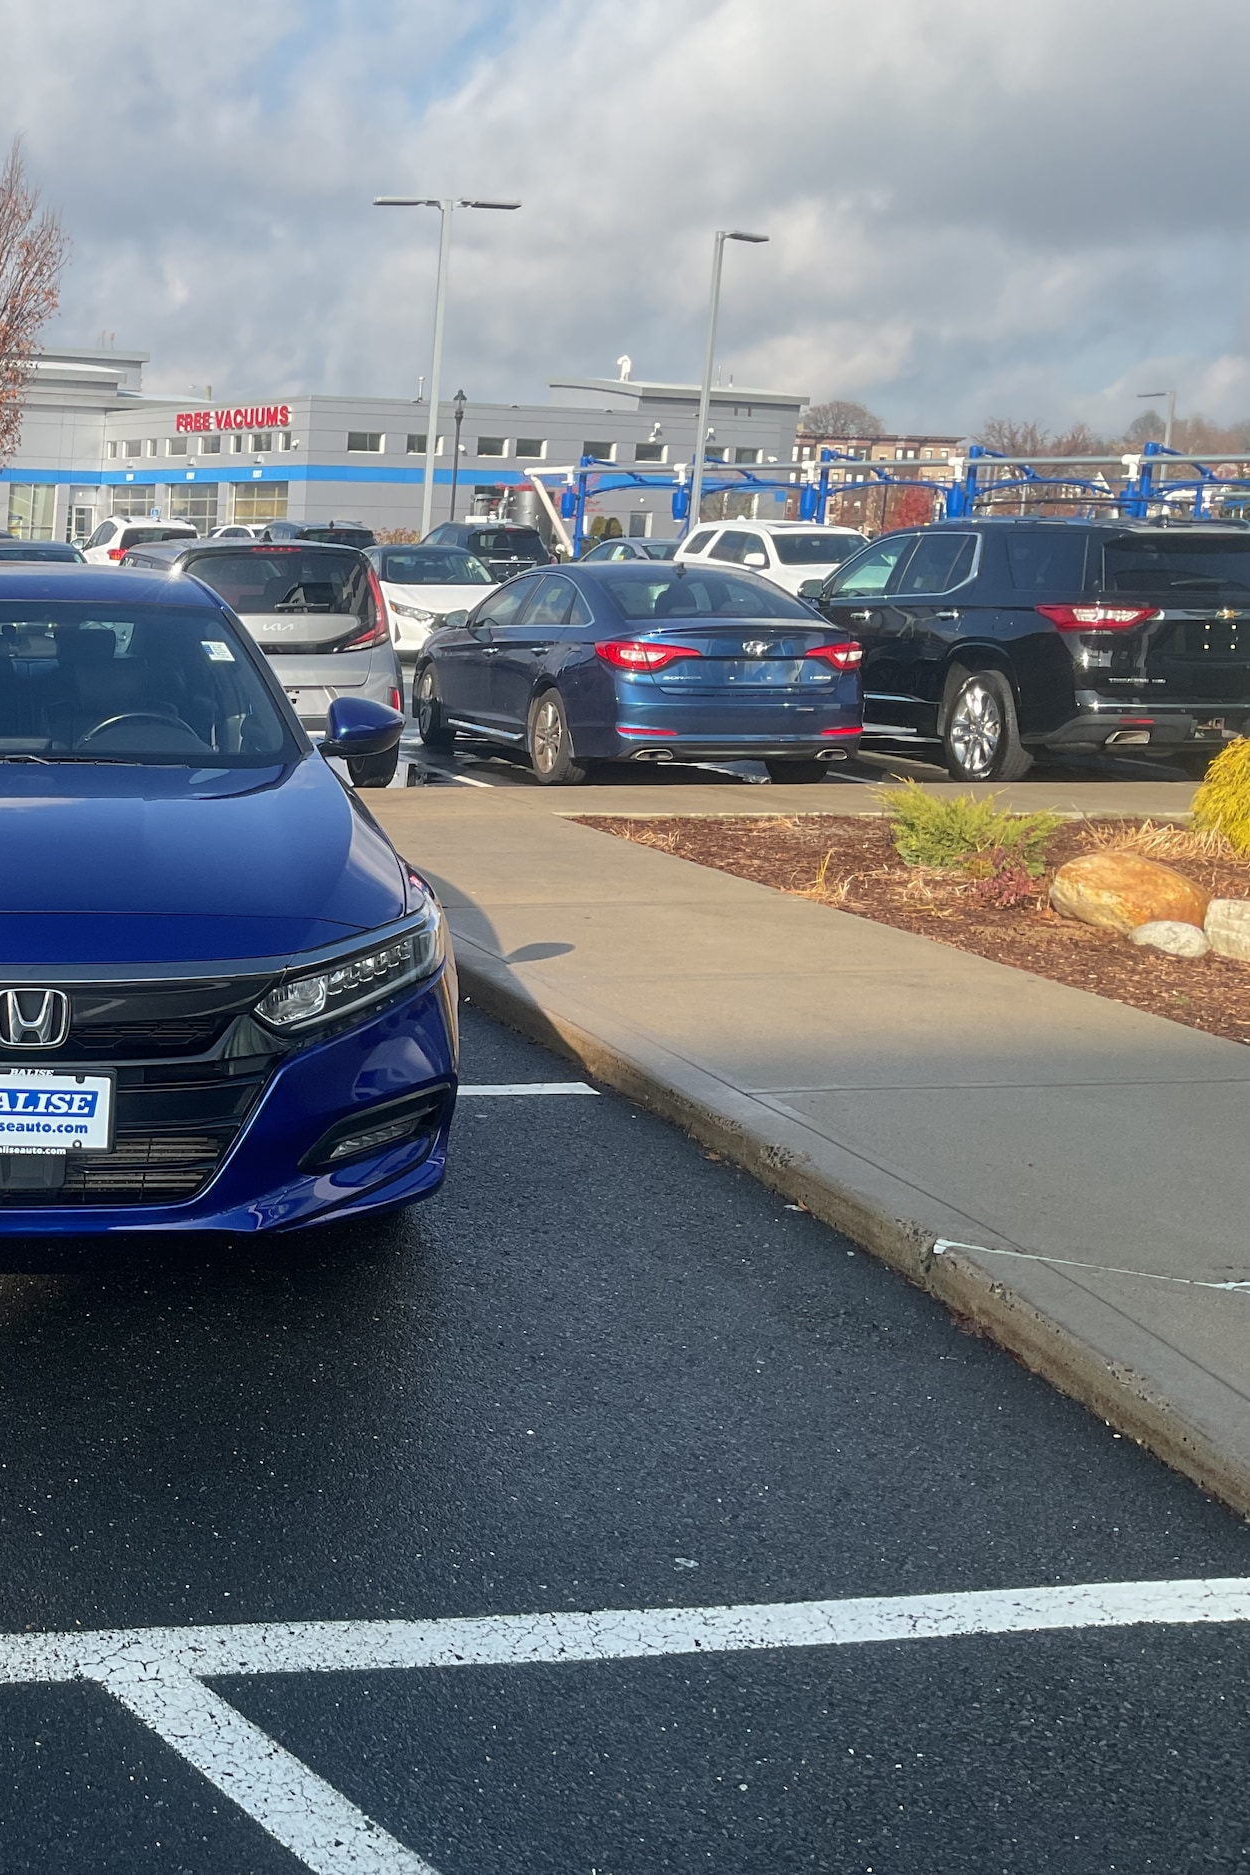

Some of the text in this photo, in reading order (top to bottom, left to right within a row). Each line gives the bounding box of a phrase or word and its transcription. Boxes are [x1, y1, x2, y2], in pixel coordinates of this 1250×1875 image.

[176, 405, 291, 432] FREE VACUUMS
[10, 1068, 54, 1077] BALISE
